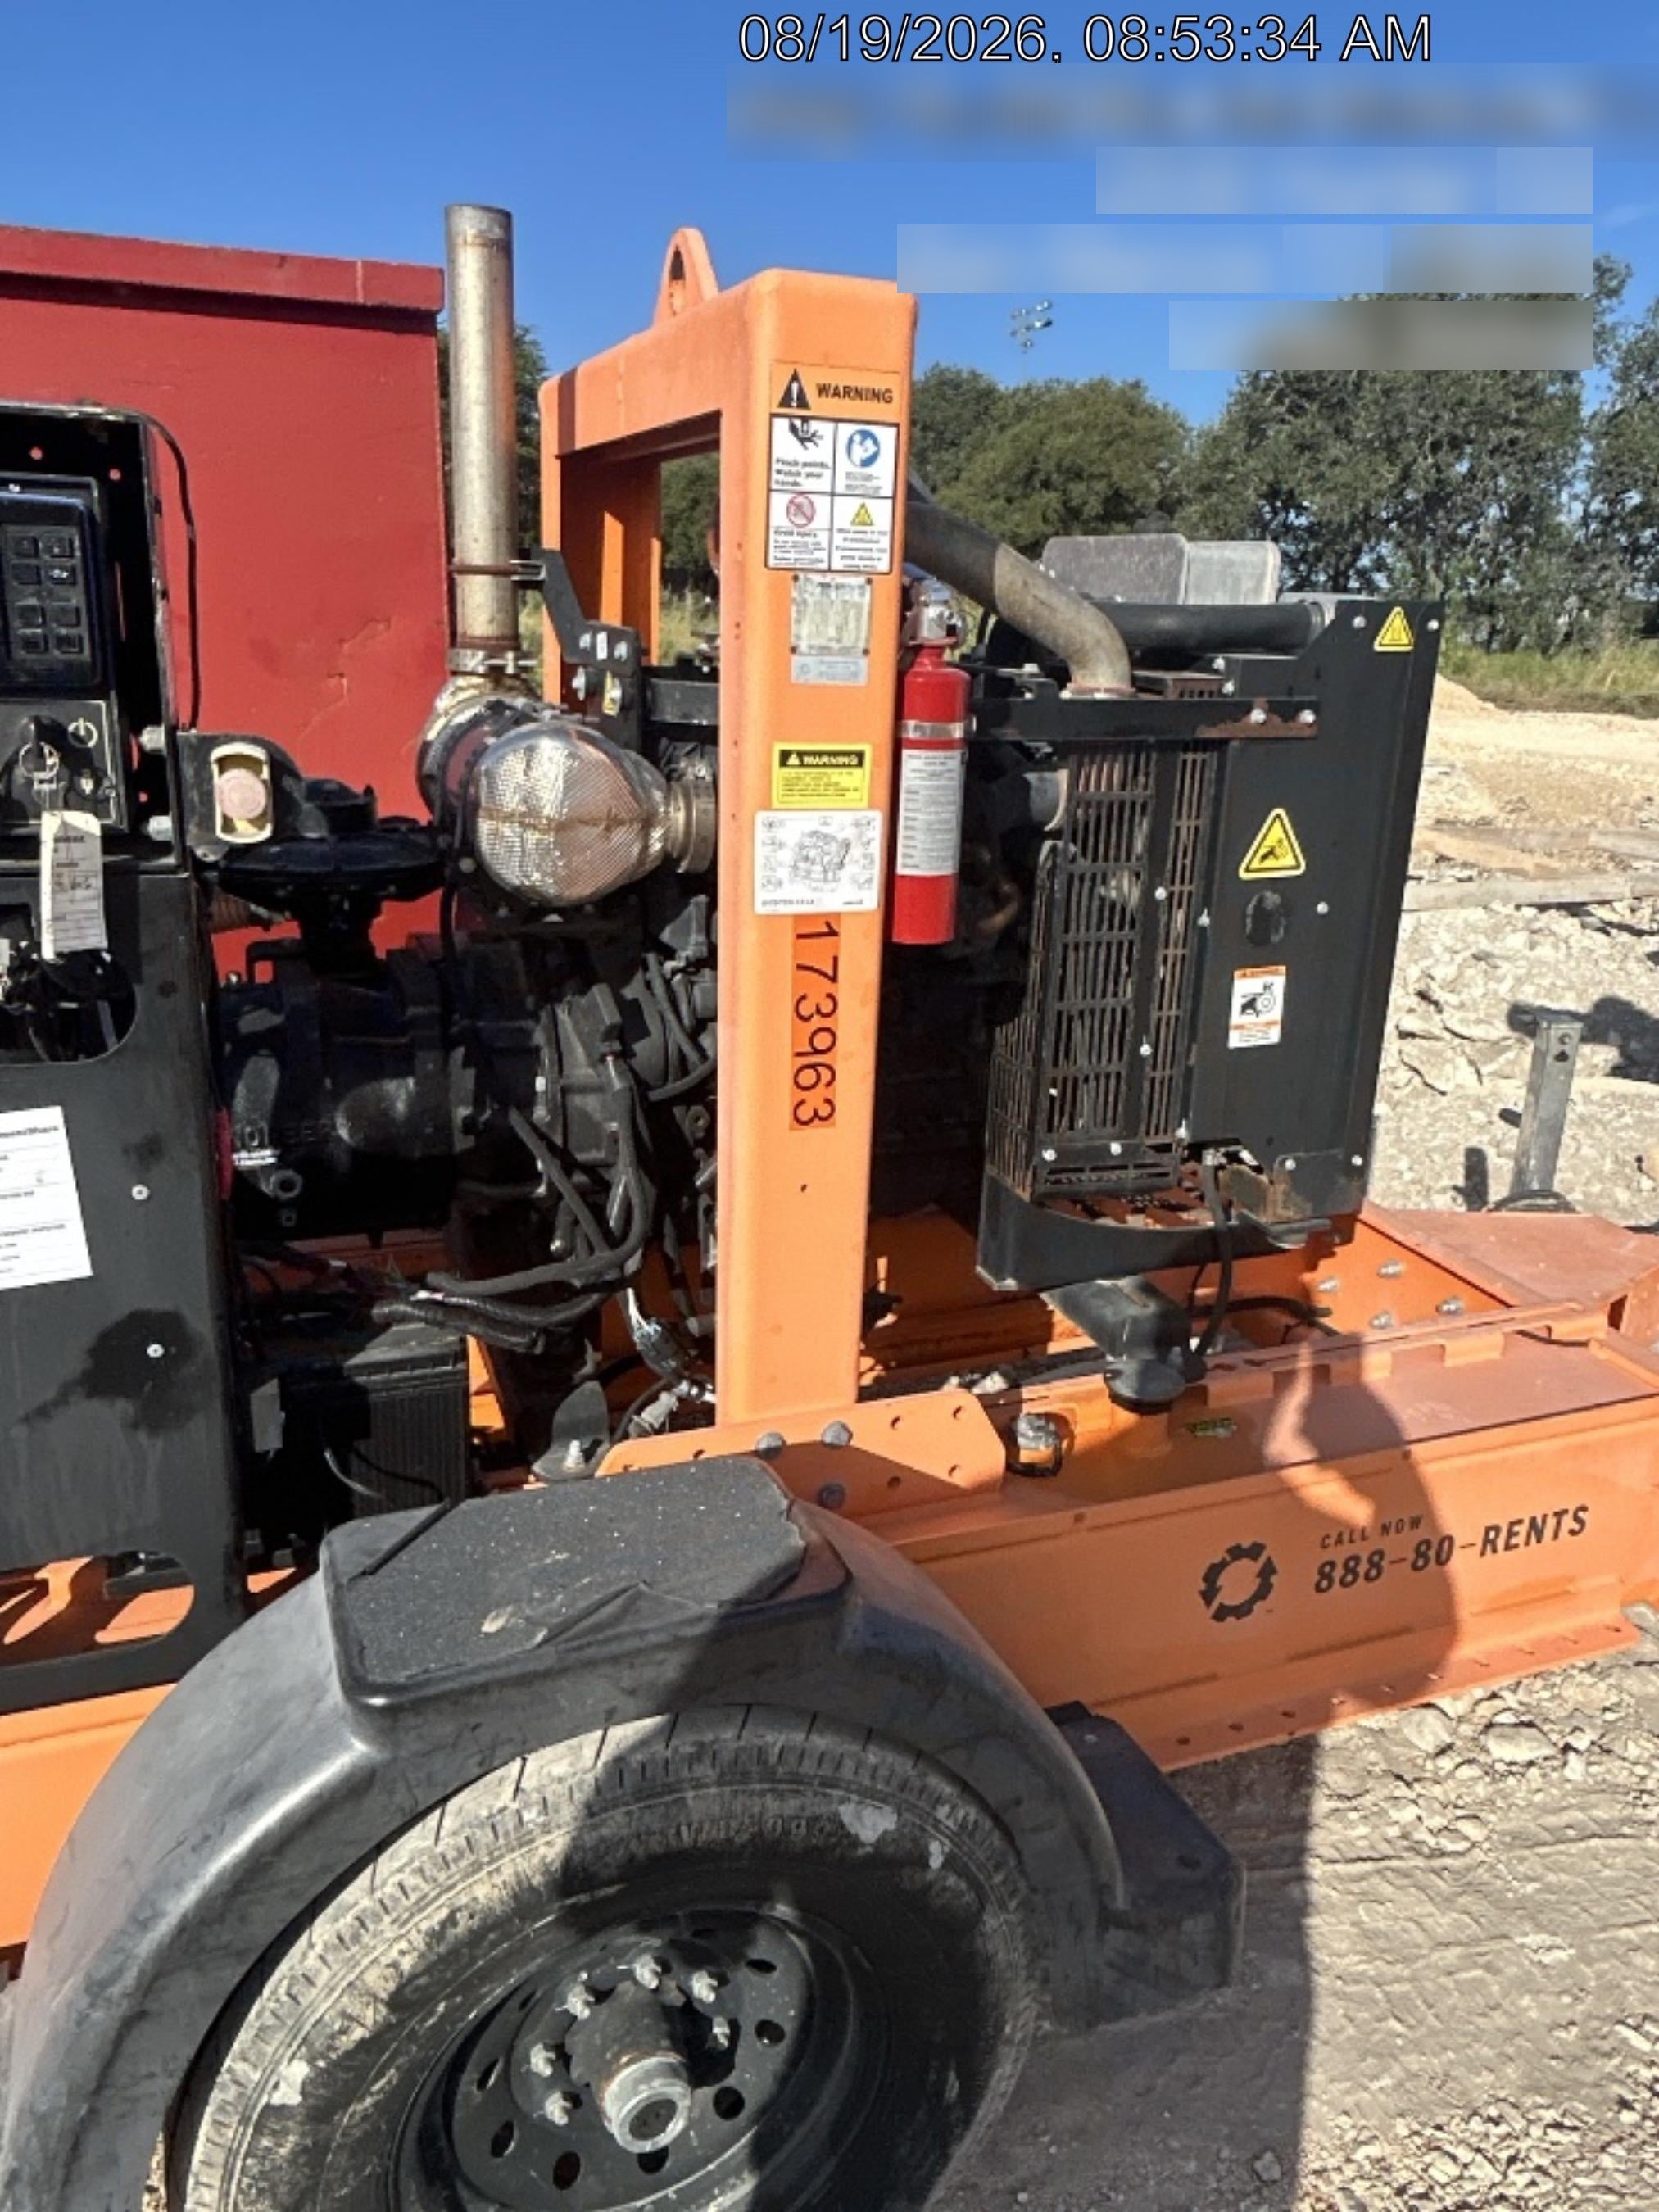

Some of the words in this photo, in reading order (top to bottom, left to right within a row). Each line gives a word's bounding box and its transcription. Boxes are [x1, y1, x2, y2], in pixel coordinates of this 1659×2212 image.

[816, 383, 893, 404] WARNING
[803, 754, 859, 765] WARNING
[792, 921, 840, 1126] 173963
[1313, 1504, 1589, 1593] 888-80-RENTS
[1321, 1525, 1370, 1549] CALL
[1380, 1514, 1423, 1537] NOW
